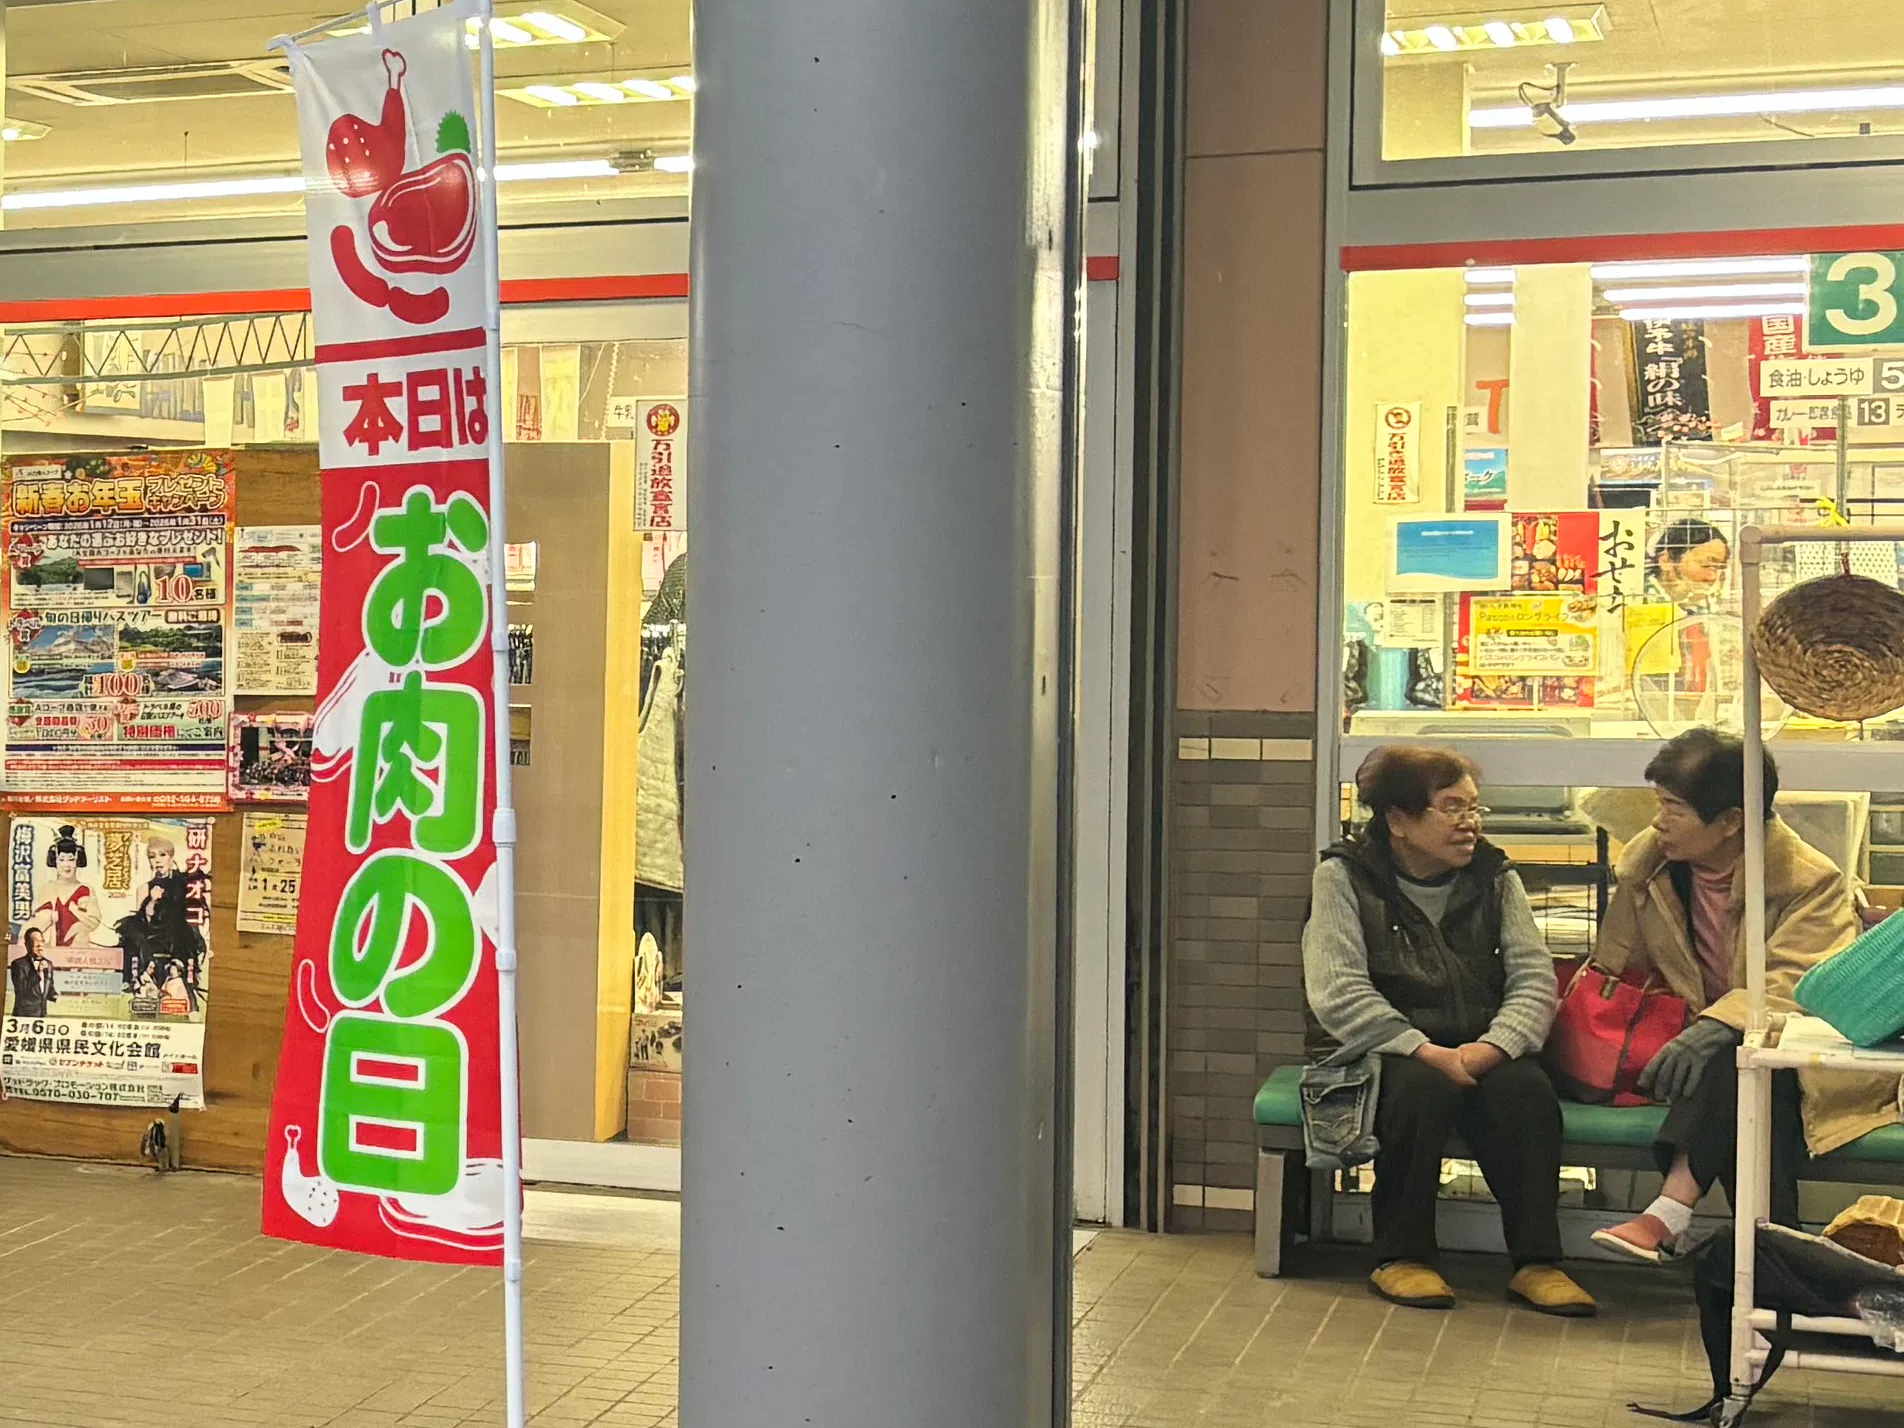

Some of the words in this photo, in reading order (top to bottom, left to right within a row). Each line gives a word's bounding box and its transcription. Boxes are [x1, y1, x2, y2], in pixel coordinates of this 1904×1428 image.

[1825, 252, 1898, 335] 3
[343, 366, 489, 456] 本日は
[1859, 400, 1886, 423] 13
[13, 477, 145, 516] 新春お年玉
[146, 474, 225, 494] プレゼント
[648, 438, 673, 528] 万引追放宣言店
[12, 824, 35, 921] 梅沢富美男
[186, 826, 208, 926] 研ナオコ
[320, 484, 492, 1196] お肉の日
[3, 1036, 162, 1059] 愛媛県県民文化会館
